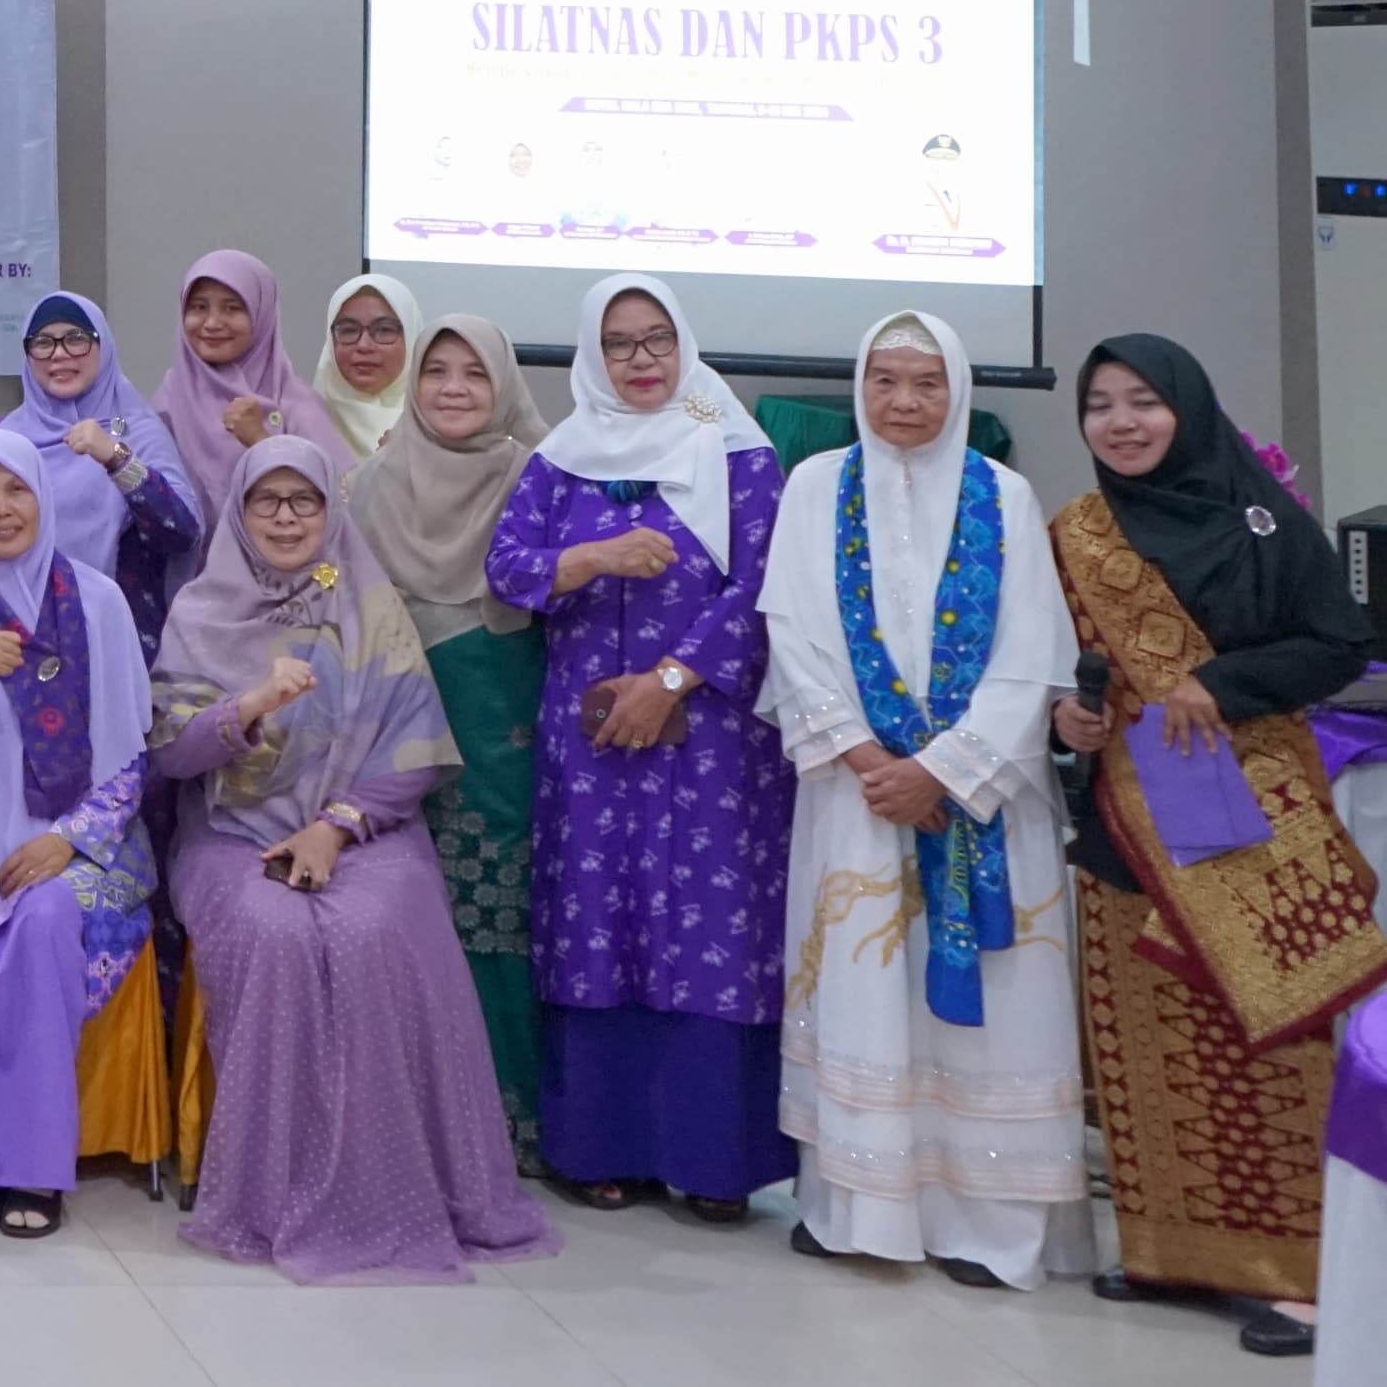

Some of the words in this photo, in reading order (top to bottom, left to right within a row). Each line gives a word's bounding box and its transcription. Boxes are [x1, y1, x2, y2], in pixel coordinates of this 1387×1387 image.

[472, 1, 662, 56] SILATNAS
[679, 8, 764, 59] DAN
[783, 11, 901, 63] PKPS
[918, 15, 943, 64] 3
[8, 263, 32, 278] BY:
